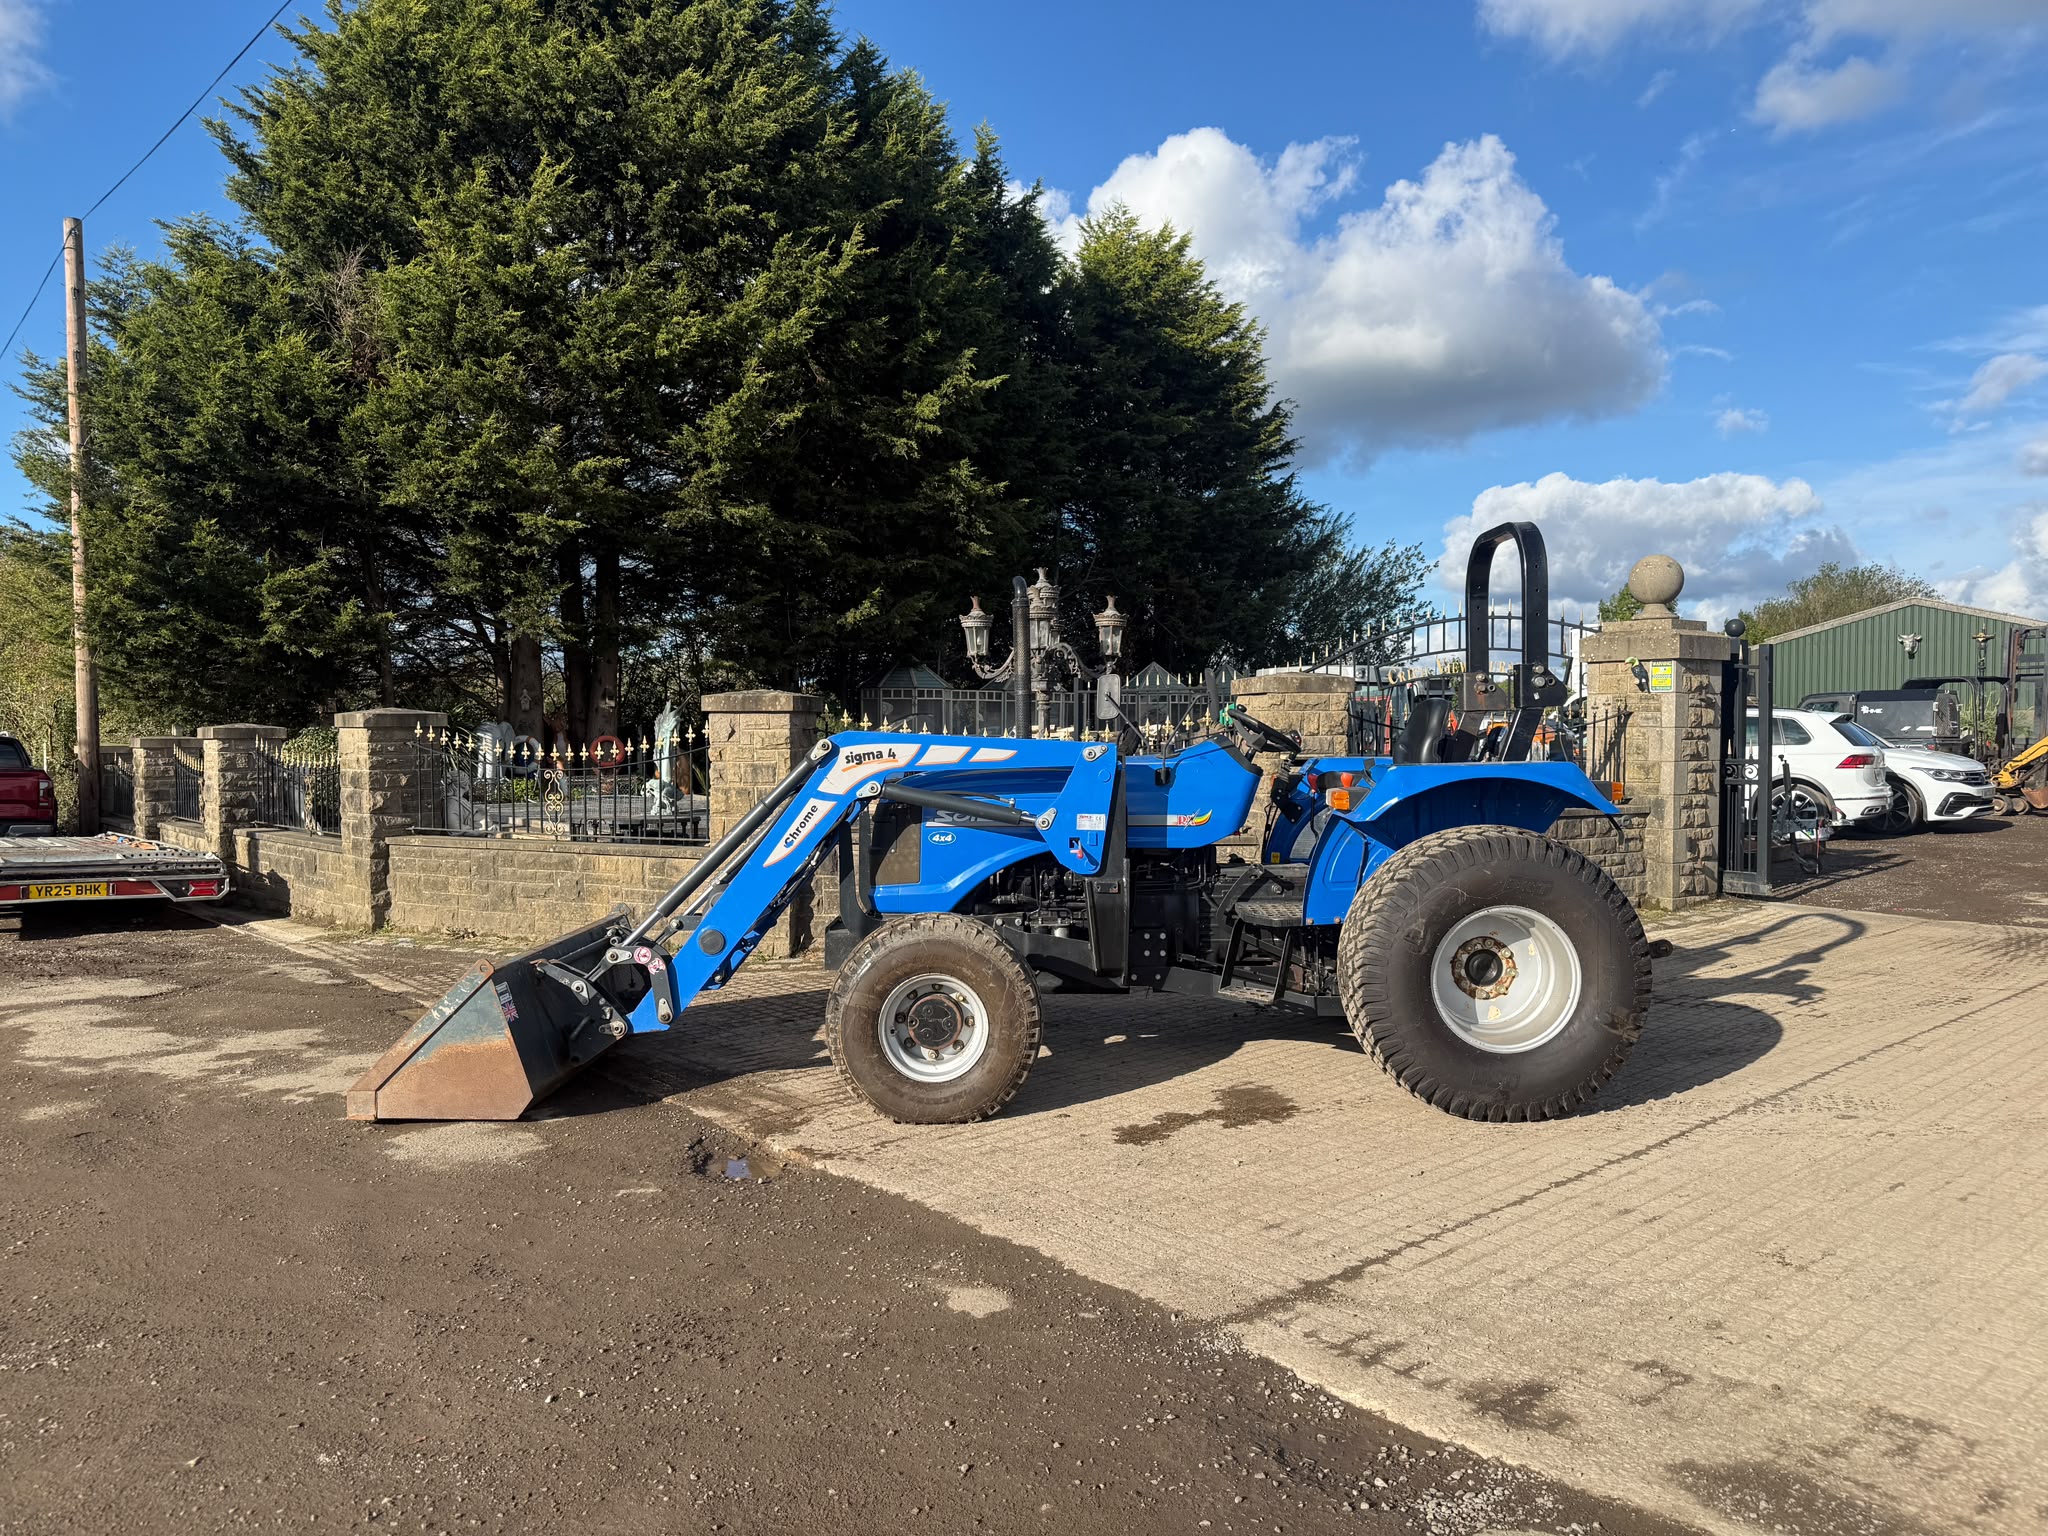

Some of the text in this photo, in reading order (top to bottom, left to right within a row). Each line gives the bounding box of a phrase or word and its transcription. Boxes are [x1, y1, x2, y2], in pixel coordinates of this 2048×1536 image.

[845, 748, 897, 765] sigma 4
[783, 804, 819, 849] Chrome
[932, 834, 953, 842] 4x4
[35, 884, 102, 897] YR25 BHK
